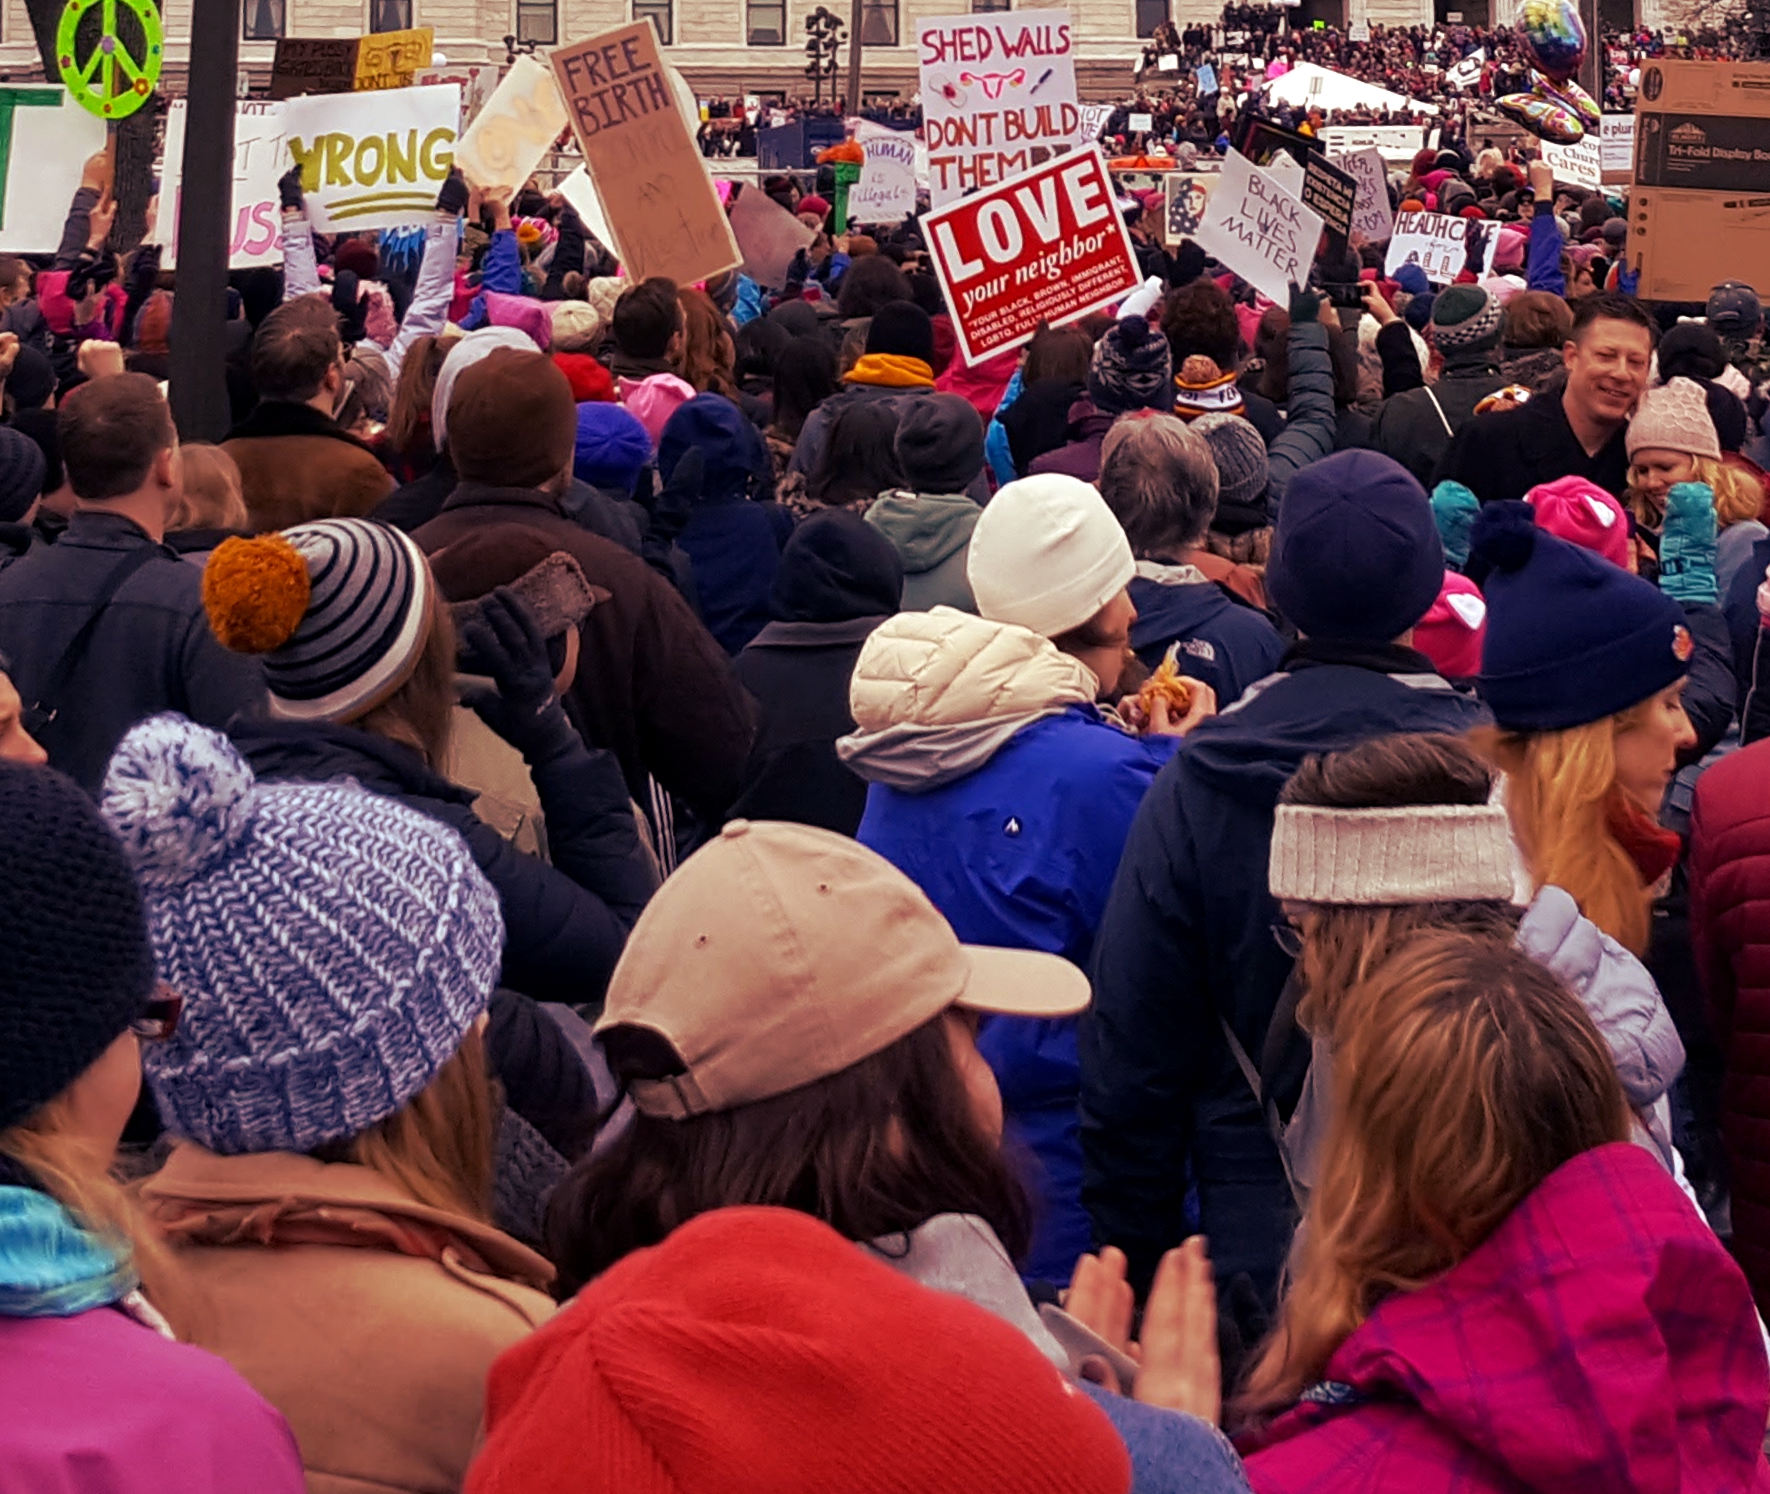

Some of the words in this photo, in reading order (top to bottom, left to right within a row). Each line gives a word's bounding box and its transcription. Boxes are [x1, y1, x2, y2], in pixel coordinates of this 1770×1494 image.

[562, 36, 653, 96] FREE
[922, 26, 993, 65] SHED
[996, 24, 1071, 58] WALLS
[573, 72, 670, 137] BIRTH
[927, 112, 998, 151] DONT
[1003, 103, 1079, 141] BUILD
[287, 127, 456, 194] WRONG
[866, 142, 914, 166] HUMAN
[930, 150, 1028, 190] THEM
[1547, 152, 1595, 177] Cares
[1669, 145, 1710, 157] Tri-Fold
[1712, 147, 1752, 161] Display
[935, 160, 1110, 282] LOVE
[1247, 174, 1303, 231] BLACK
[1220, 215, 1299, 279] MATTER
[1240, 197, 1297, 255] LIVES
[1395, 212, 1498, 243] HEALTHCE
[961, 274, 1010, 318] your
[1043, 299, 1078, 322] HUMAN
